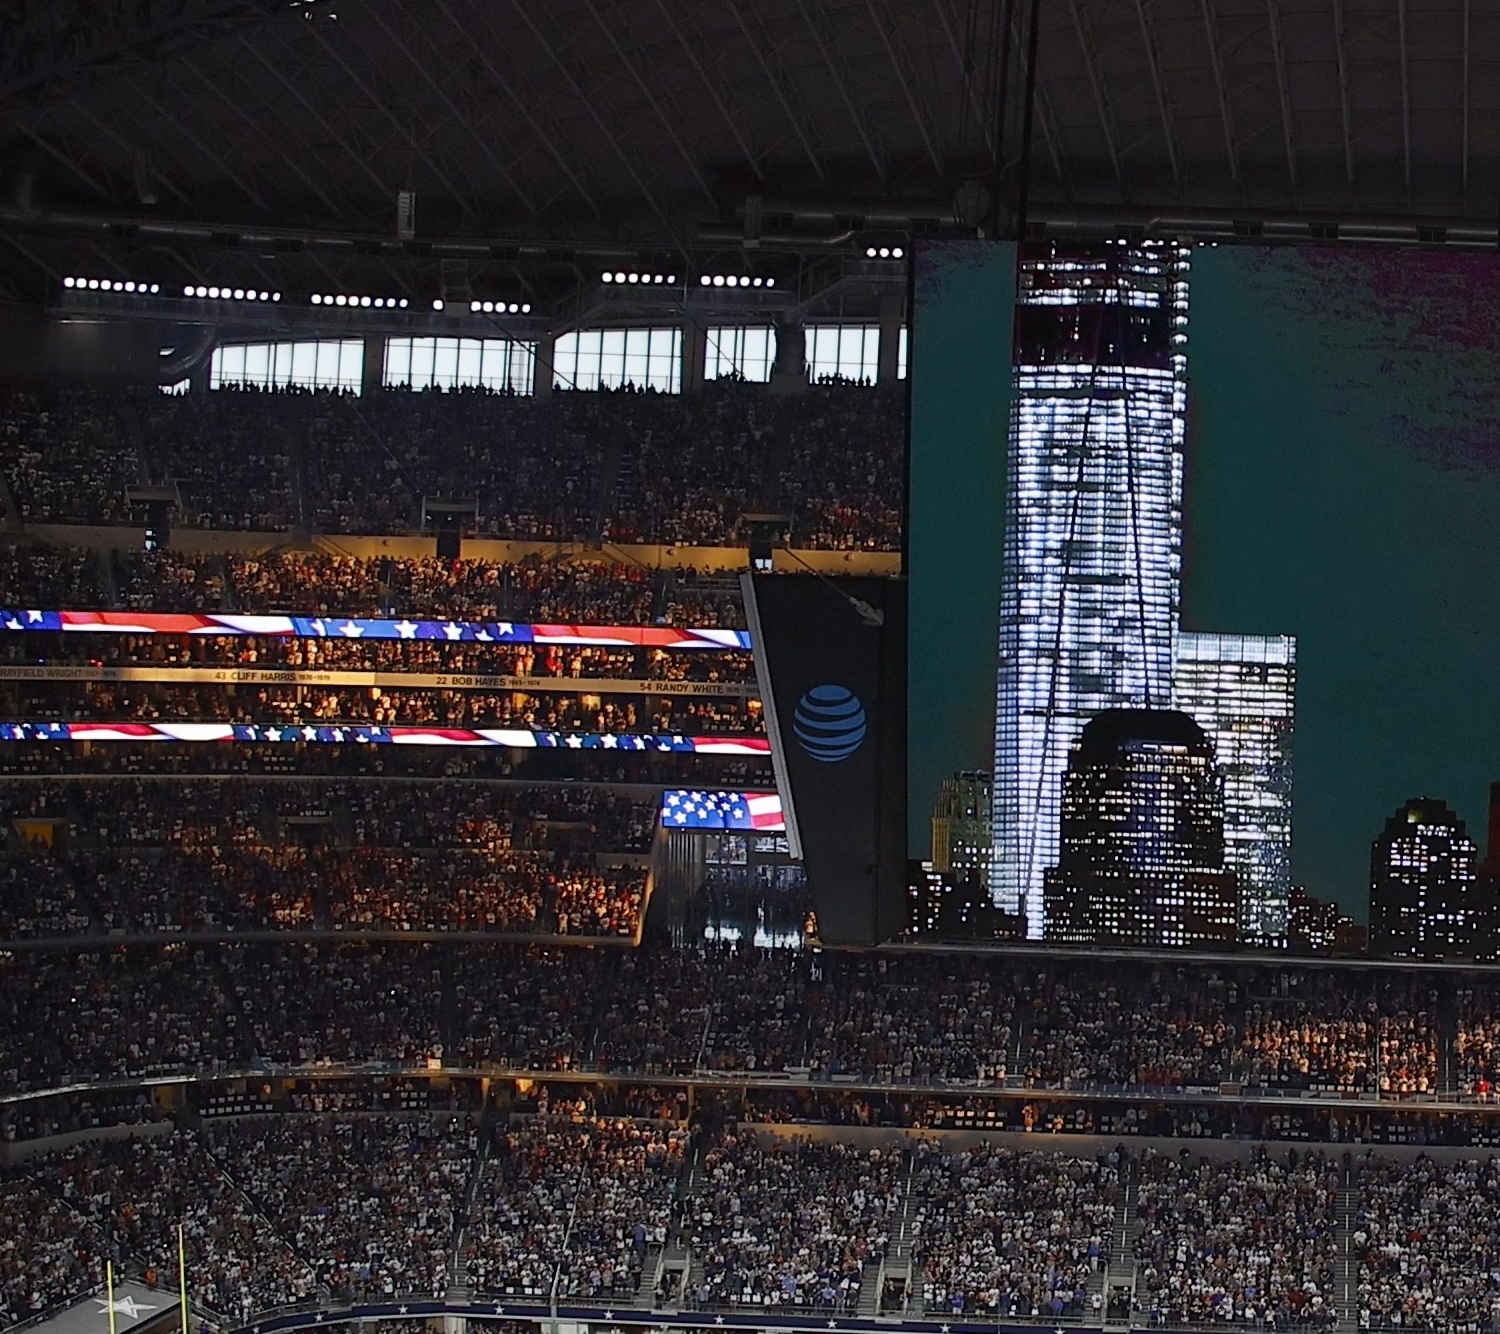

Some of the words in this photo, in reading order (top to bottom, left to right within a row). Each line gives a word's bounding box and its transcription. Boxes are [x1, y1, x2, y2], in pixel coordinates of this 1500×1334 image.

[47, 668, 82, 678] WRIGHT
[215, 671, 227, 679] 43
[231, 672, 258, 680] CLIFF
[261, 673, 296, 681] HARRIS
[436, 677, 447, 685] 22
[452, 677, 473, 685] BOB
[475, 677, 506, 686] HAYES
[640, 683, 652, 691] 54
[656, 684, 689, 692] RANDY
[692, 685, 724, 693] WHITE
